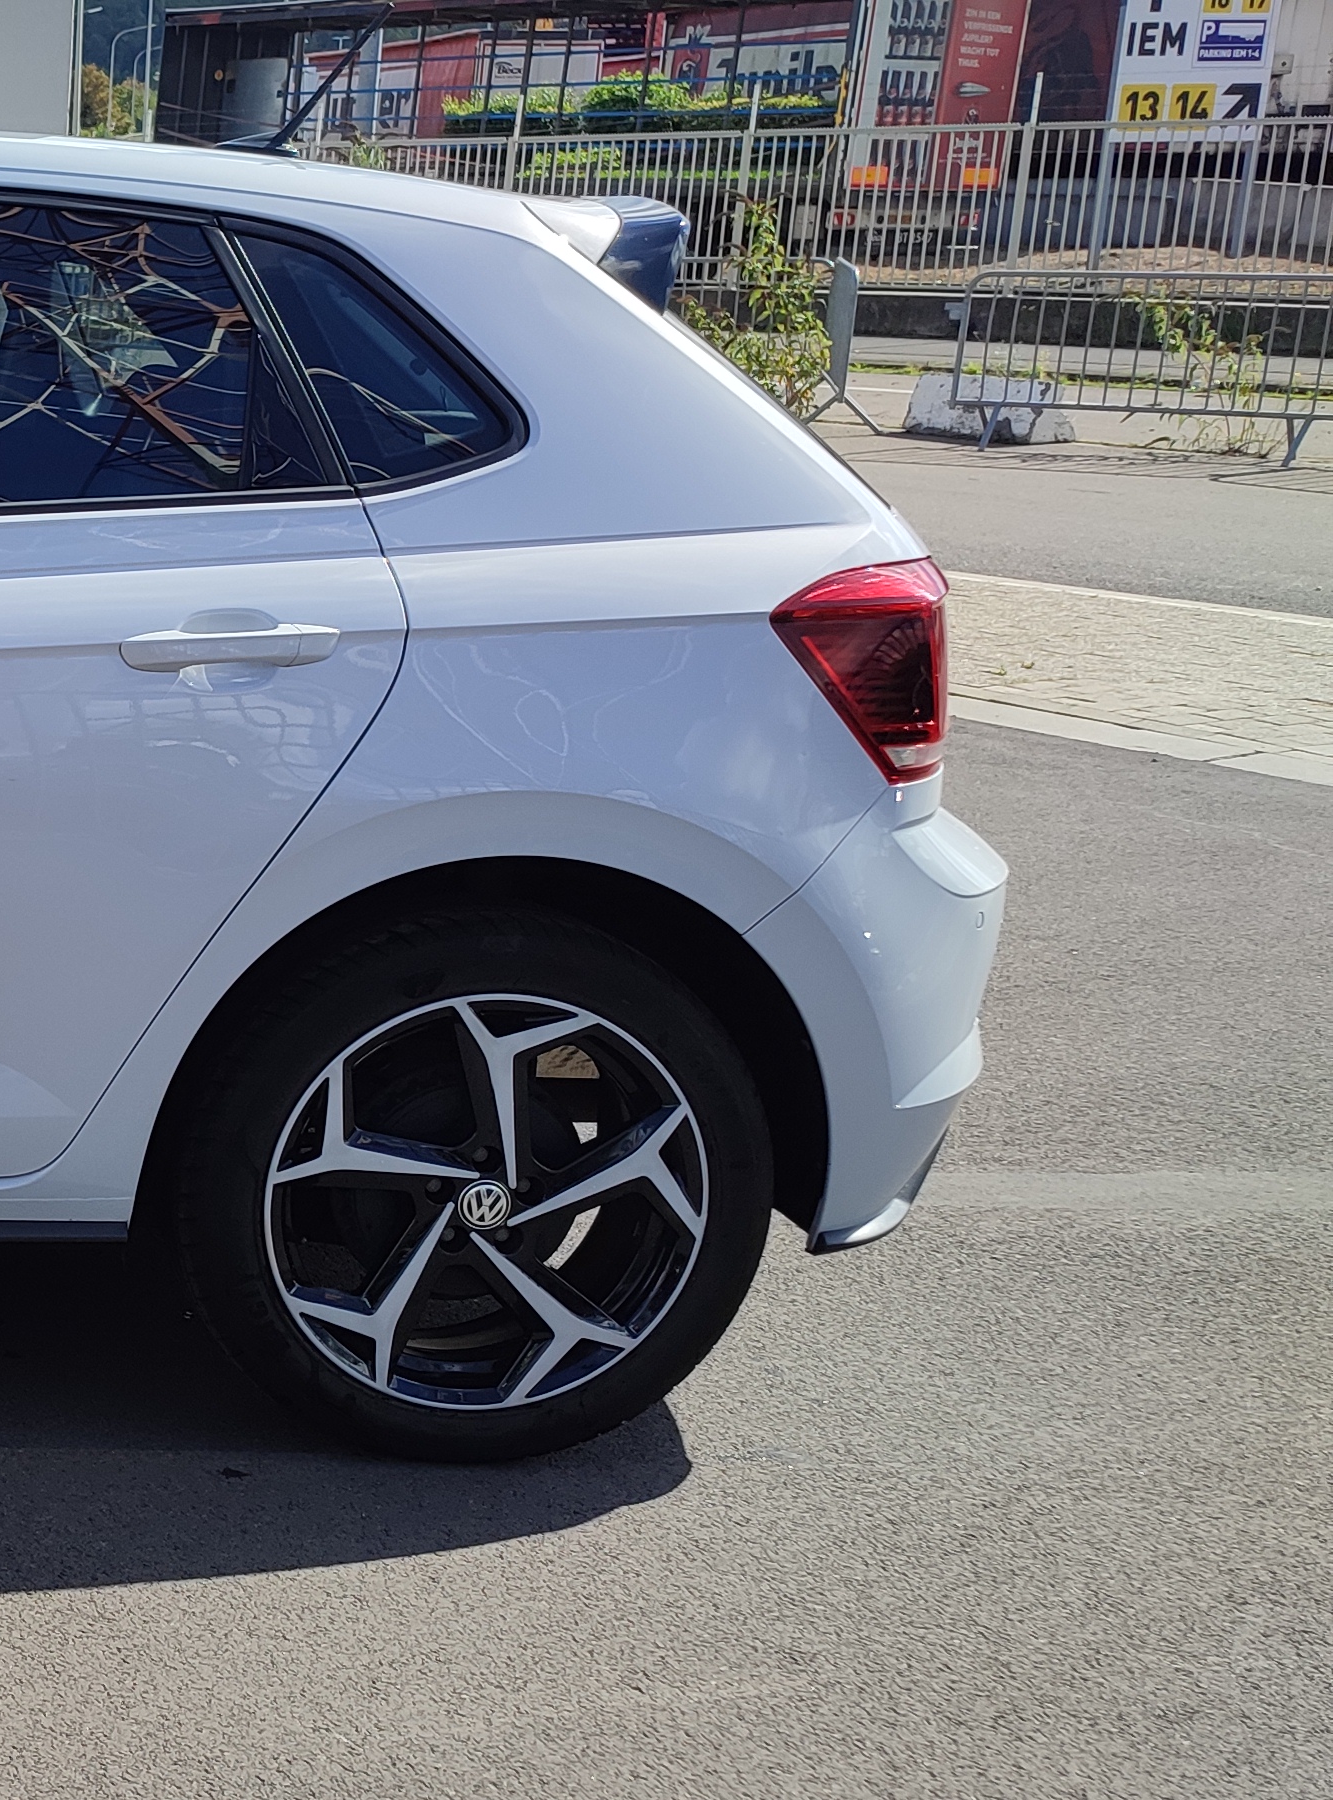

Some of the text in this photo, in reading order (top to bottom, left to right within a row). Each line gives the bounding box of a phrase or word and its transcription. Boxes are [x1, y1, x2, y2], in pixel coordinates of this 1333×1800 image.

[1126, 22, 1188, 56] IEM
[1201, 21, 1216, 43] P
[1199, 49, 1232, 58] PARKING
[1126, 91, 1160, 121] 13
[1176, 91, 1209, 120] 14
